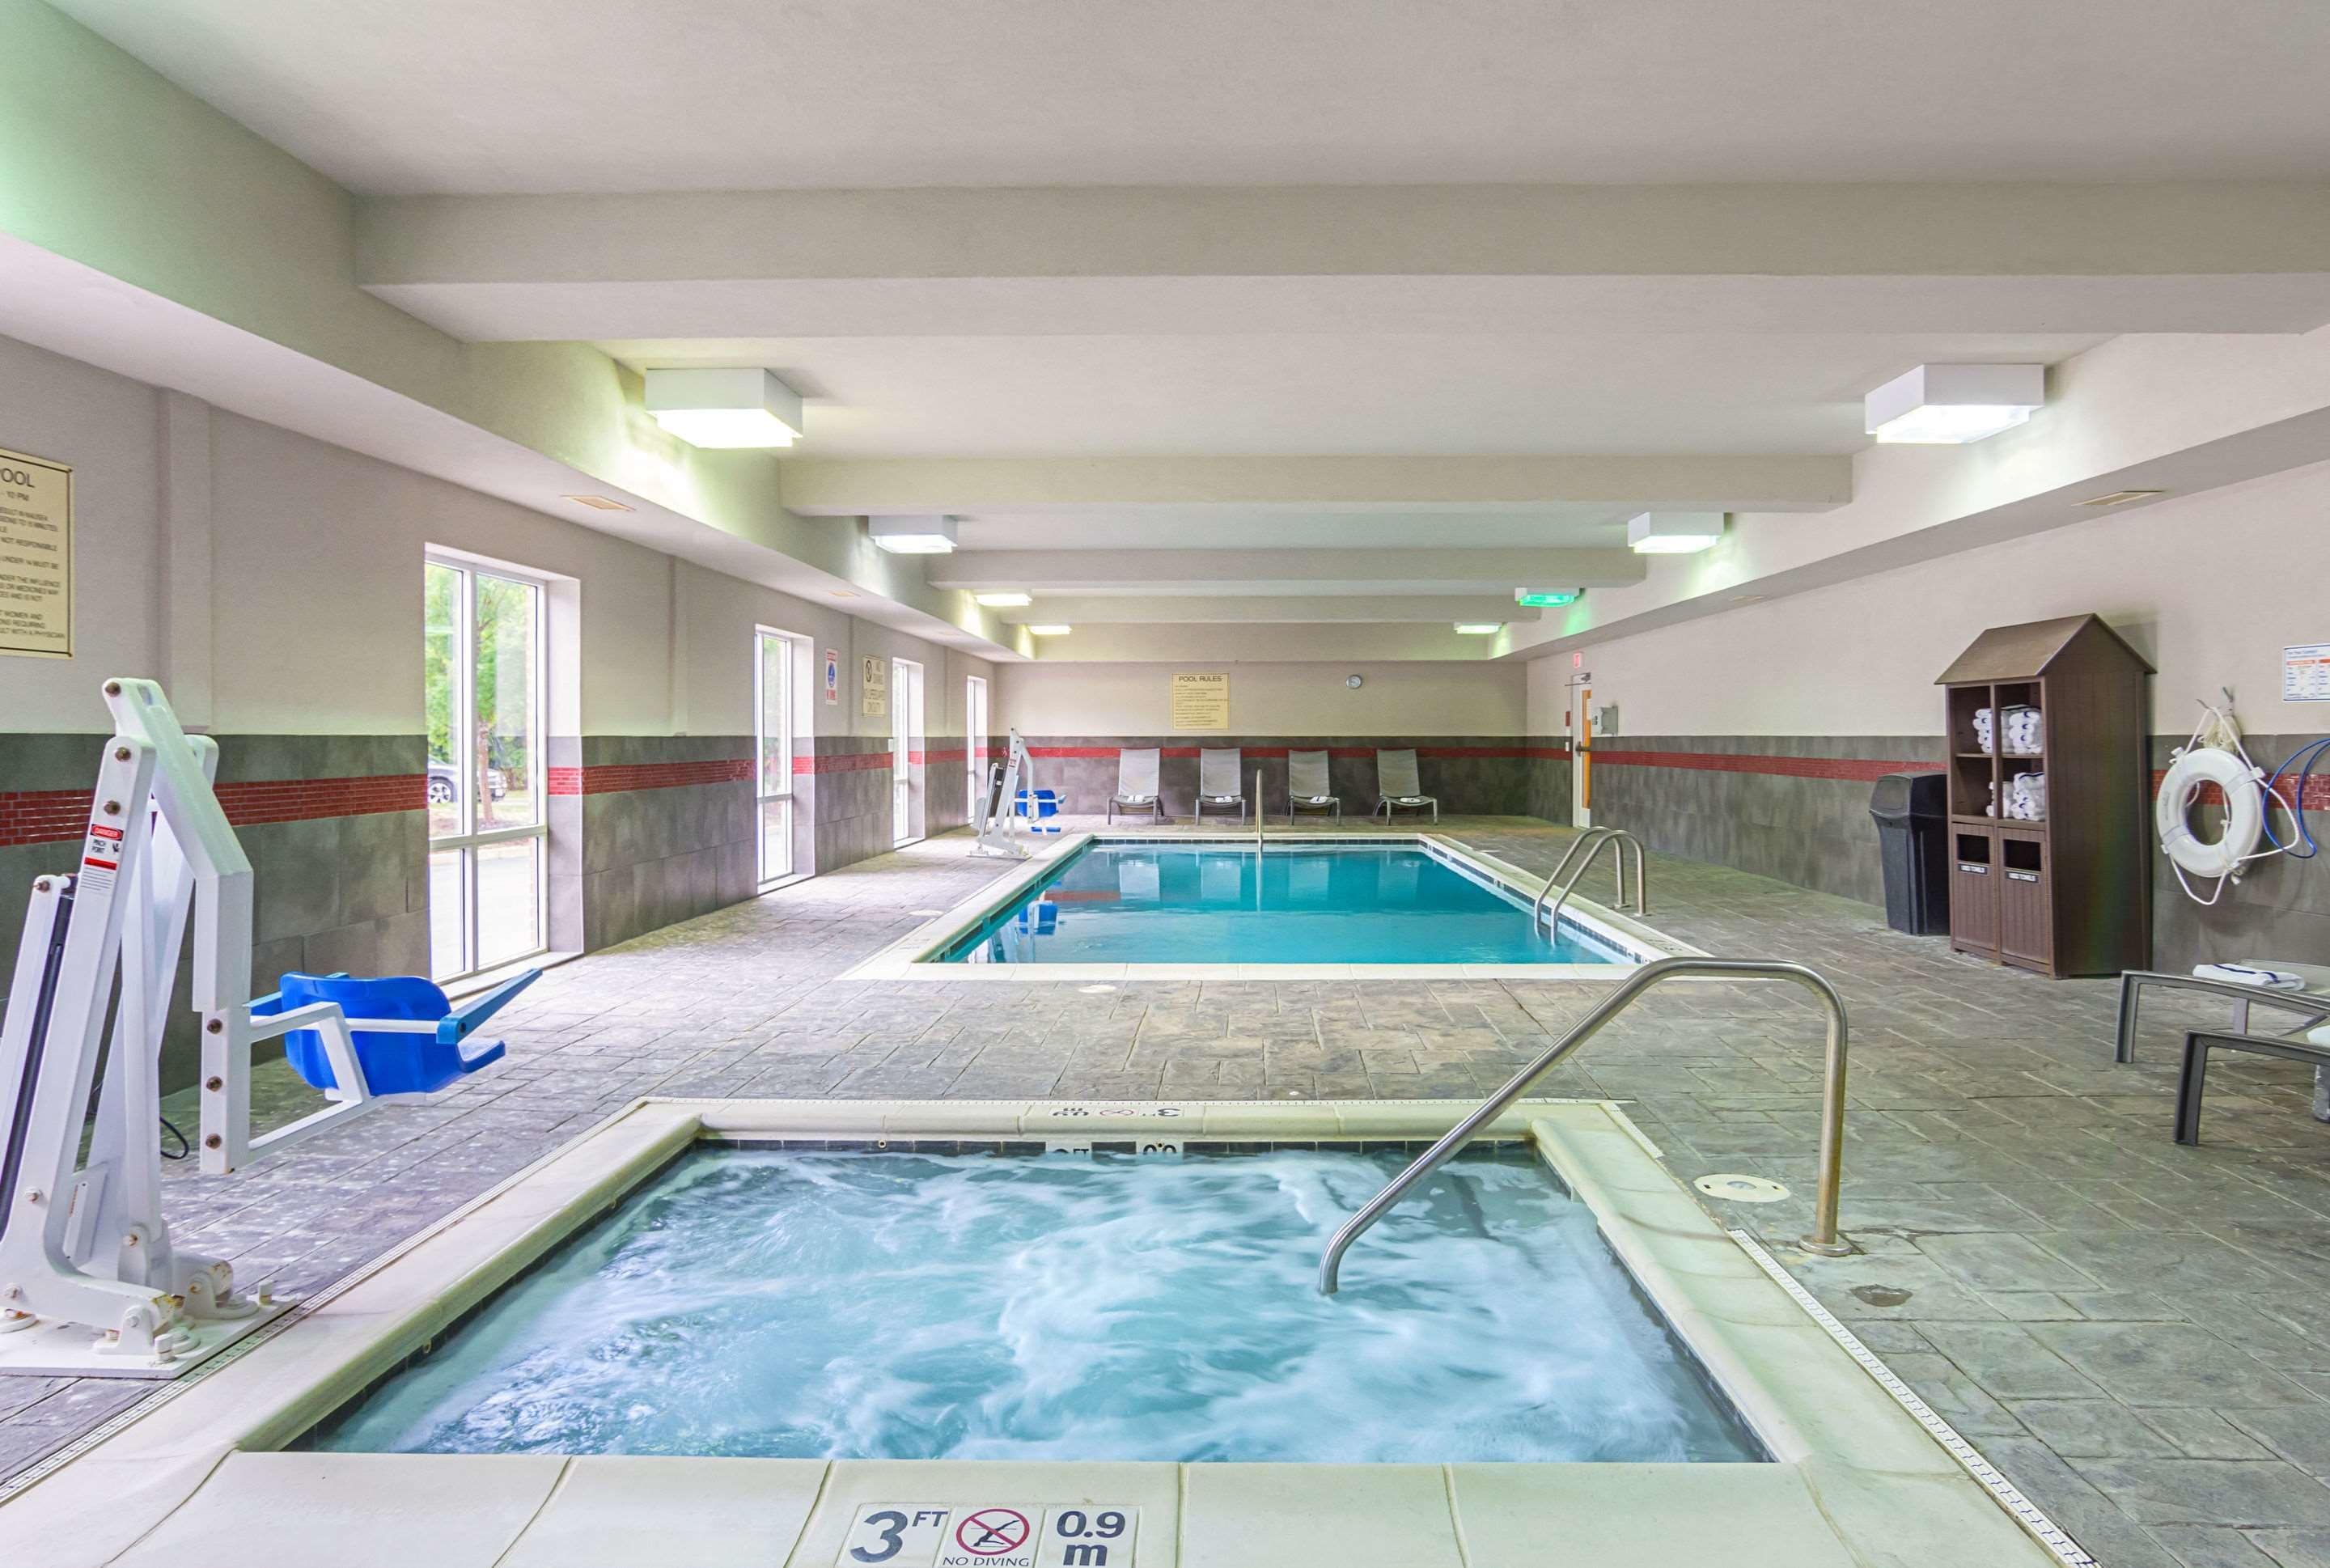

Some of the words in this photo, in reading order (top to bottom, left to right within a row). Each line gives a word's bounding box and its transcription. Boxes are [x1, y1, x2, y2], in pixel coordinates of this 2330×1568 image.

[0, 468, 36, 488] OOL
[1056, 1510, 1126, 1538] 0.9
[850, 1511, 909, 1563] 3
[912, 1511, 948, 1528] FT
[943, 1556, 969, 1567] NO
[973, 1556, 1030, 1567] DIVING
[1062, 1543, 1108, 1566] m
